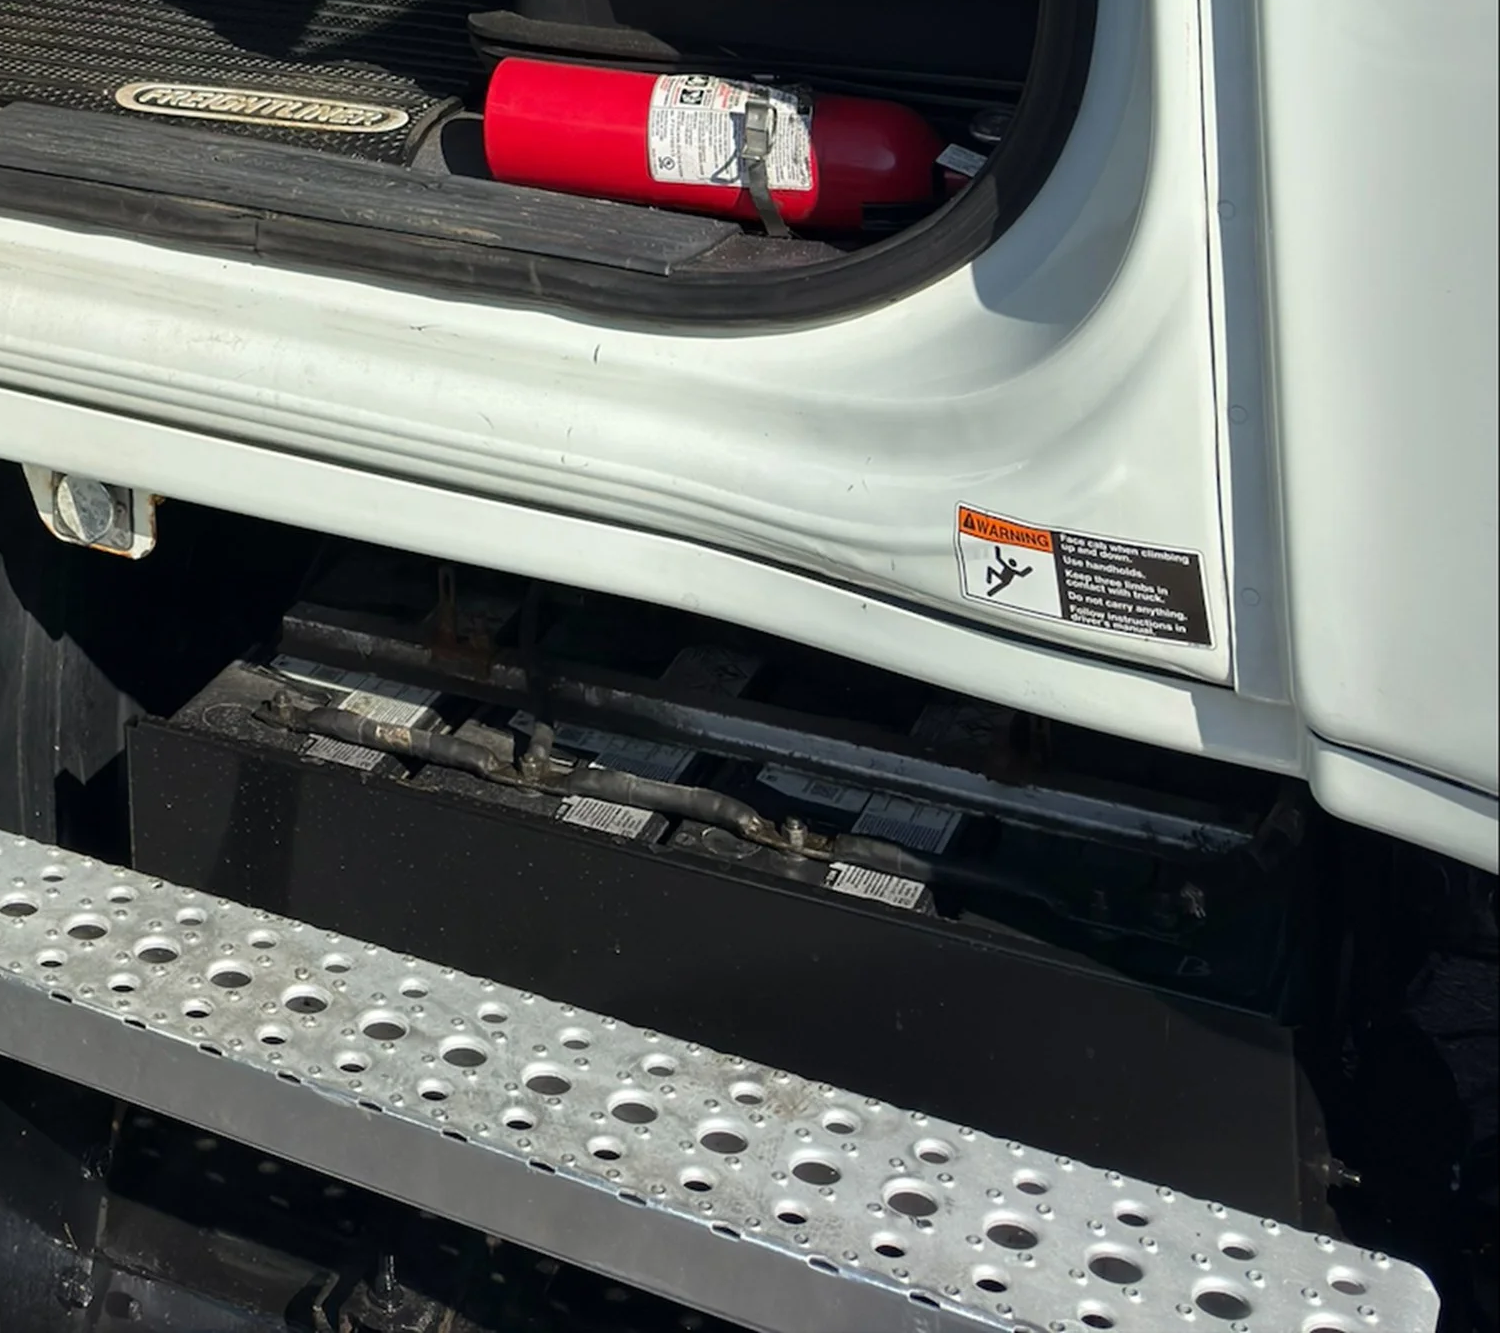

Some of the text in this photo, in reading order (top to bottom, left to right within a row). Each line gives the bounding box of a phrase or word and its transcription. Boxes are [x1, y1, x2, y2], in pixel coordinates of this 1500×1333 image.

[138, 89, 382, 125] FREIGHTLINER
[977, 520, 1049, 547] WARNING
[1059, 533, 1190, 565] Face cab when climbing
[1061, 544, 1133, 563] up and down.
[1063, 556, 1146, 579] Use handholds.
[1064, 569, 1169, 596] Keep three limbs in
[1066, 579, 1165, 603] contact with truck.
[1068, 591, 1187, 621] Do not carry anything.
[1070, 604, 1187, 634] Follow instructions in
[1071, 613, 1156, 636] driver's manual.
